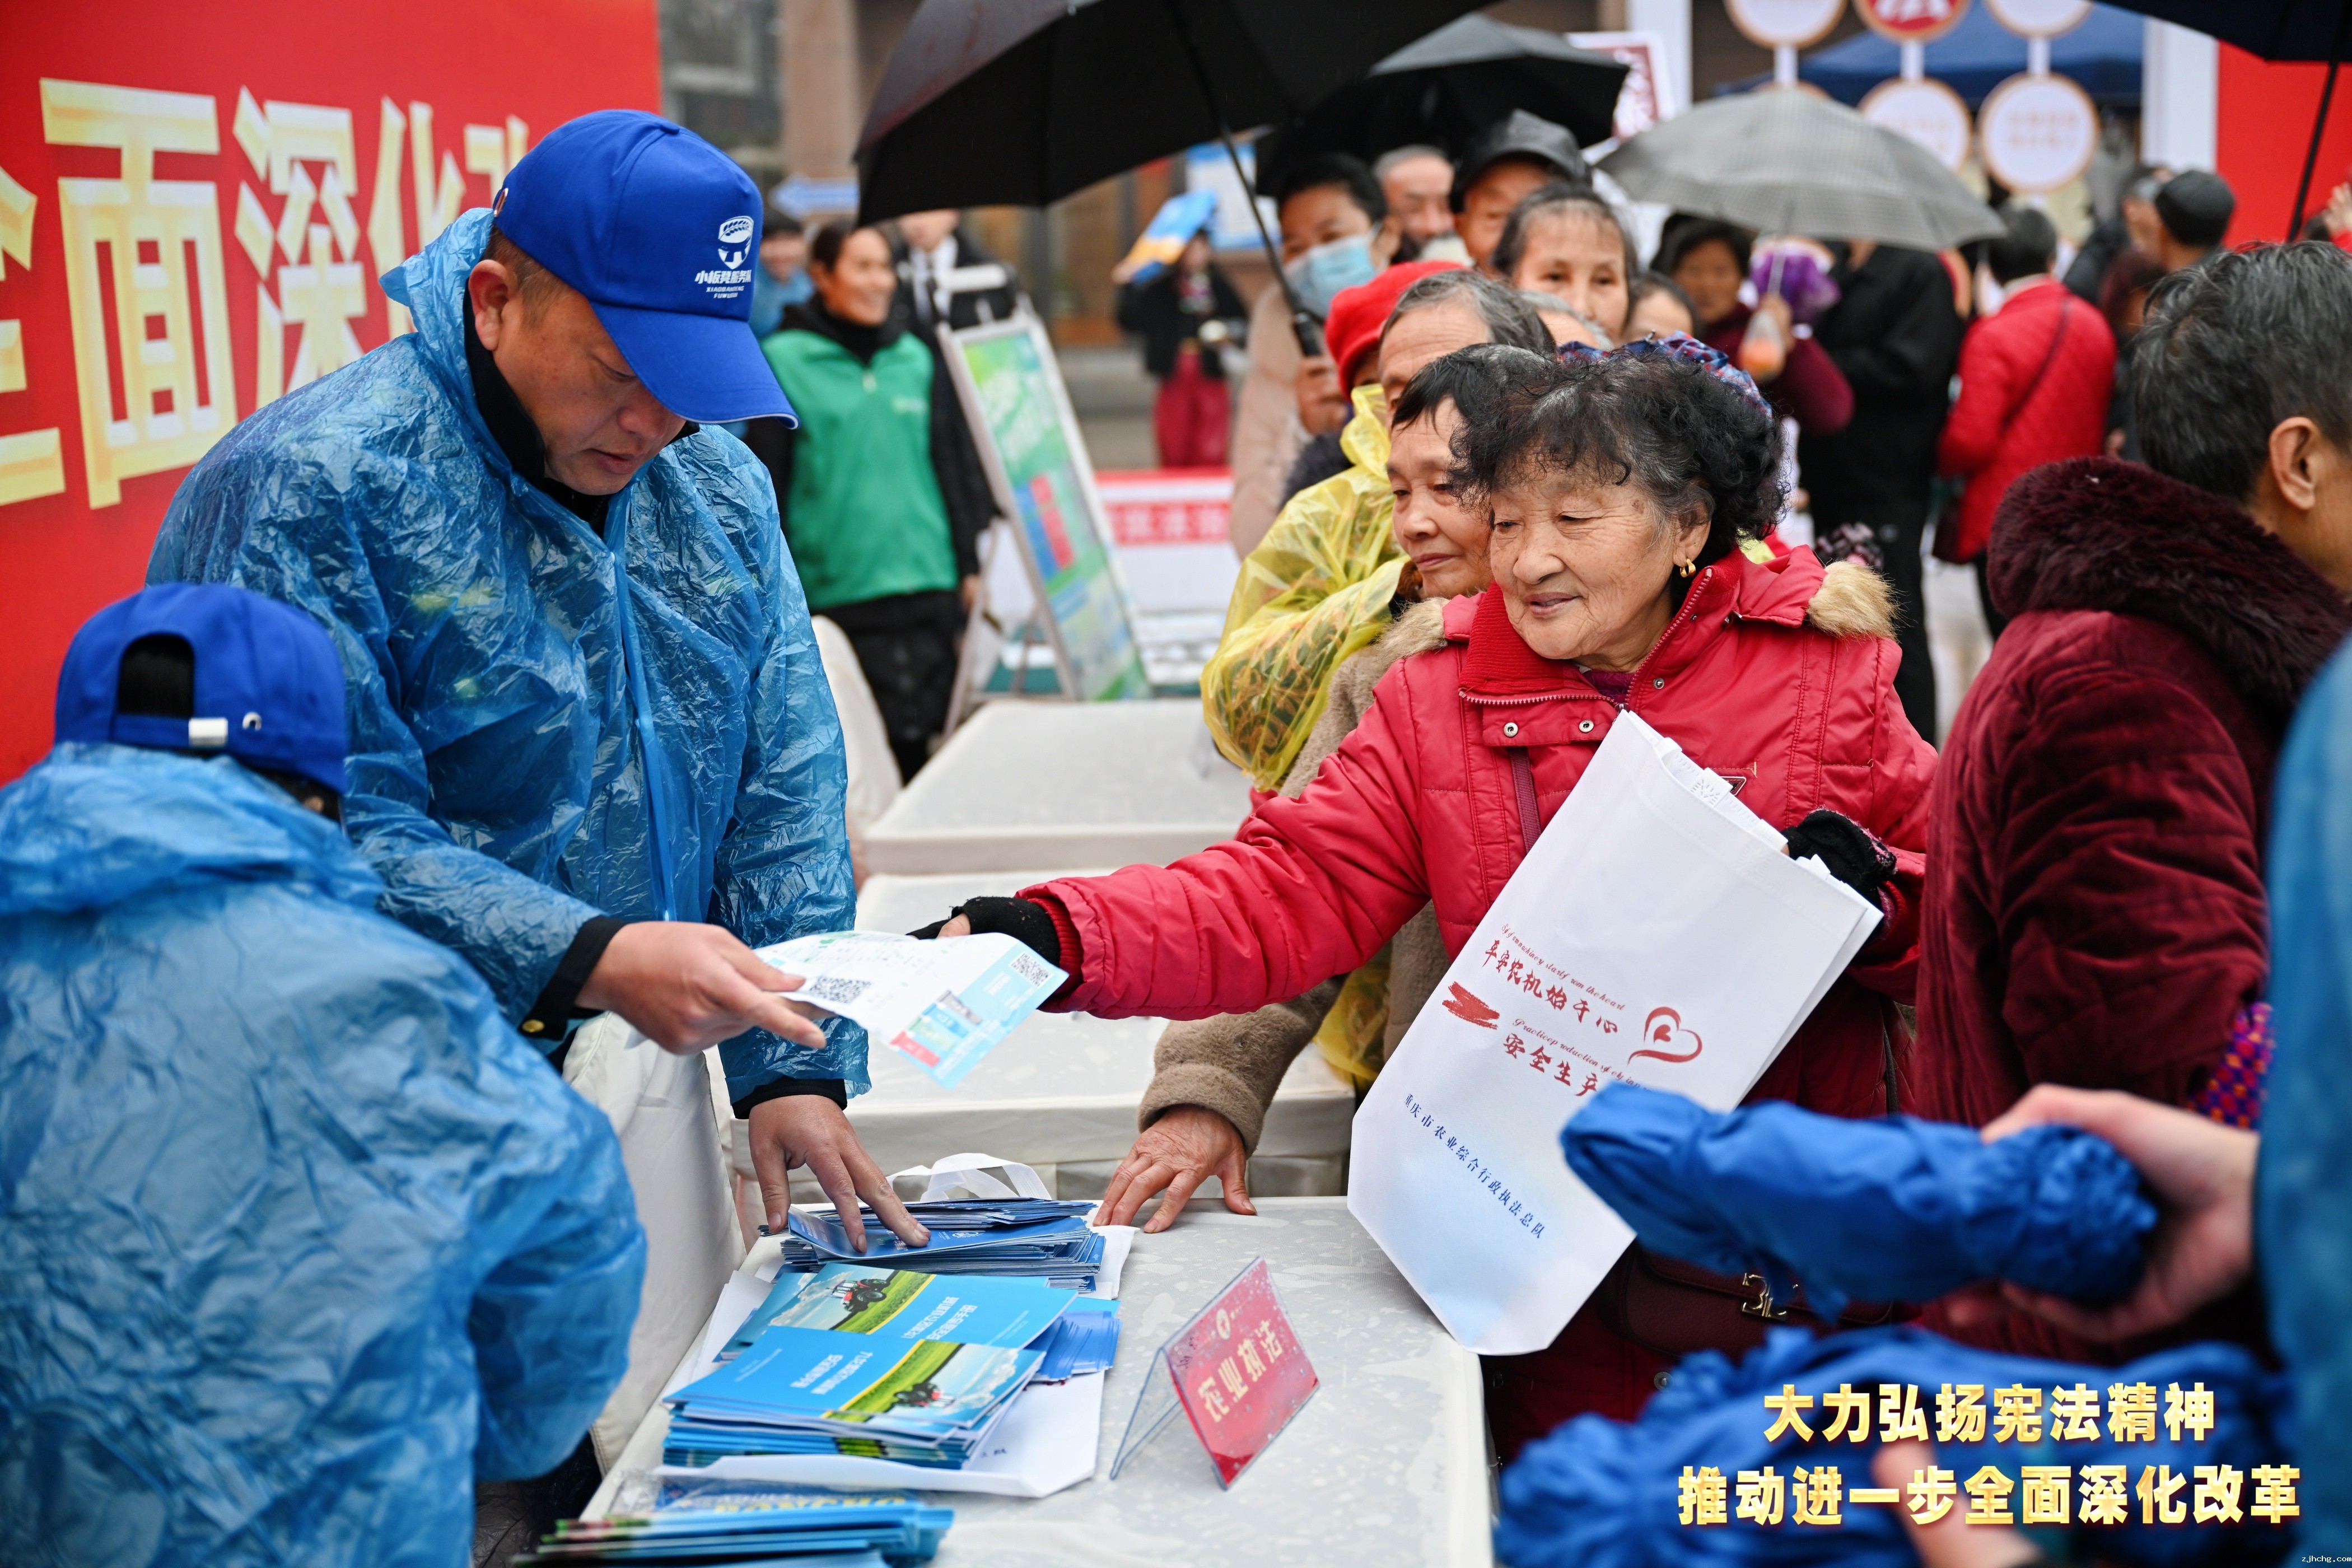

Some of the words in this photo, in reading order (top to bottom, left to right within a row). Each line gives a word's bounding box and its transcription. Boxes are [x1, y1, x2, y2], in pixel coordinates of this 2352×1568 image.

[1404, 1093, 1545, 1239] 重庆市农业综合行政执法总队
[1197, 1319, 1284, 1423] 农业执法
